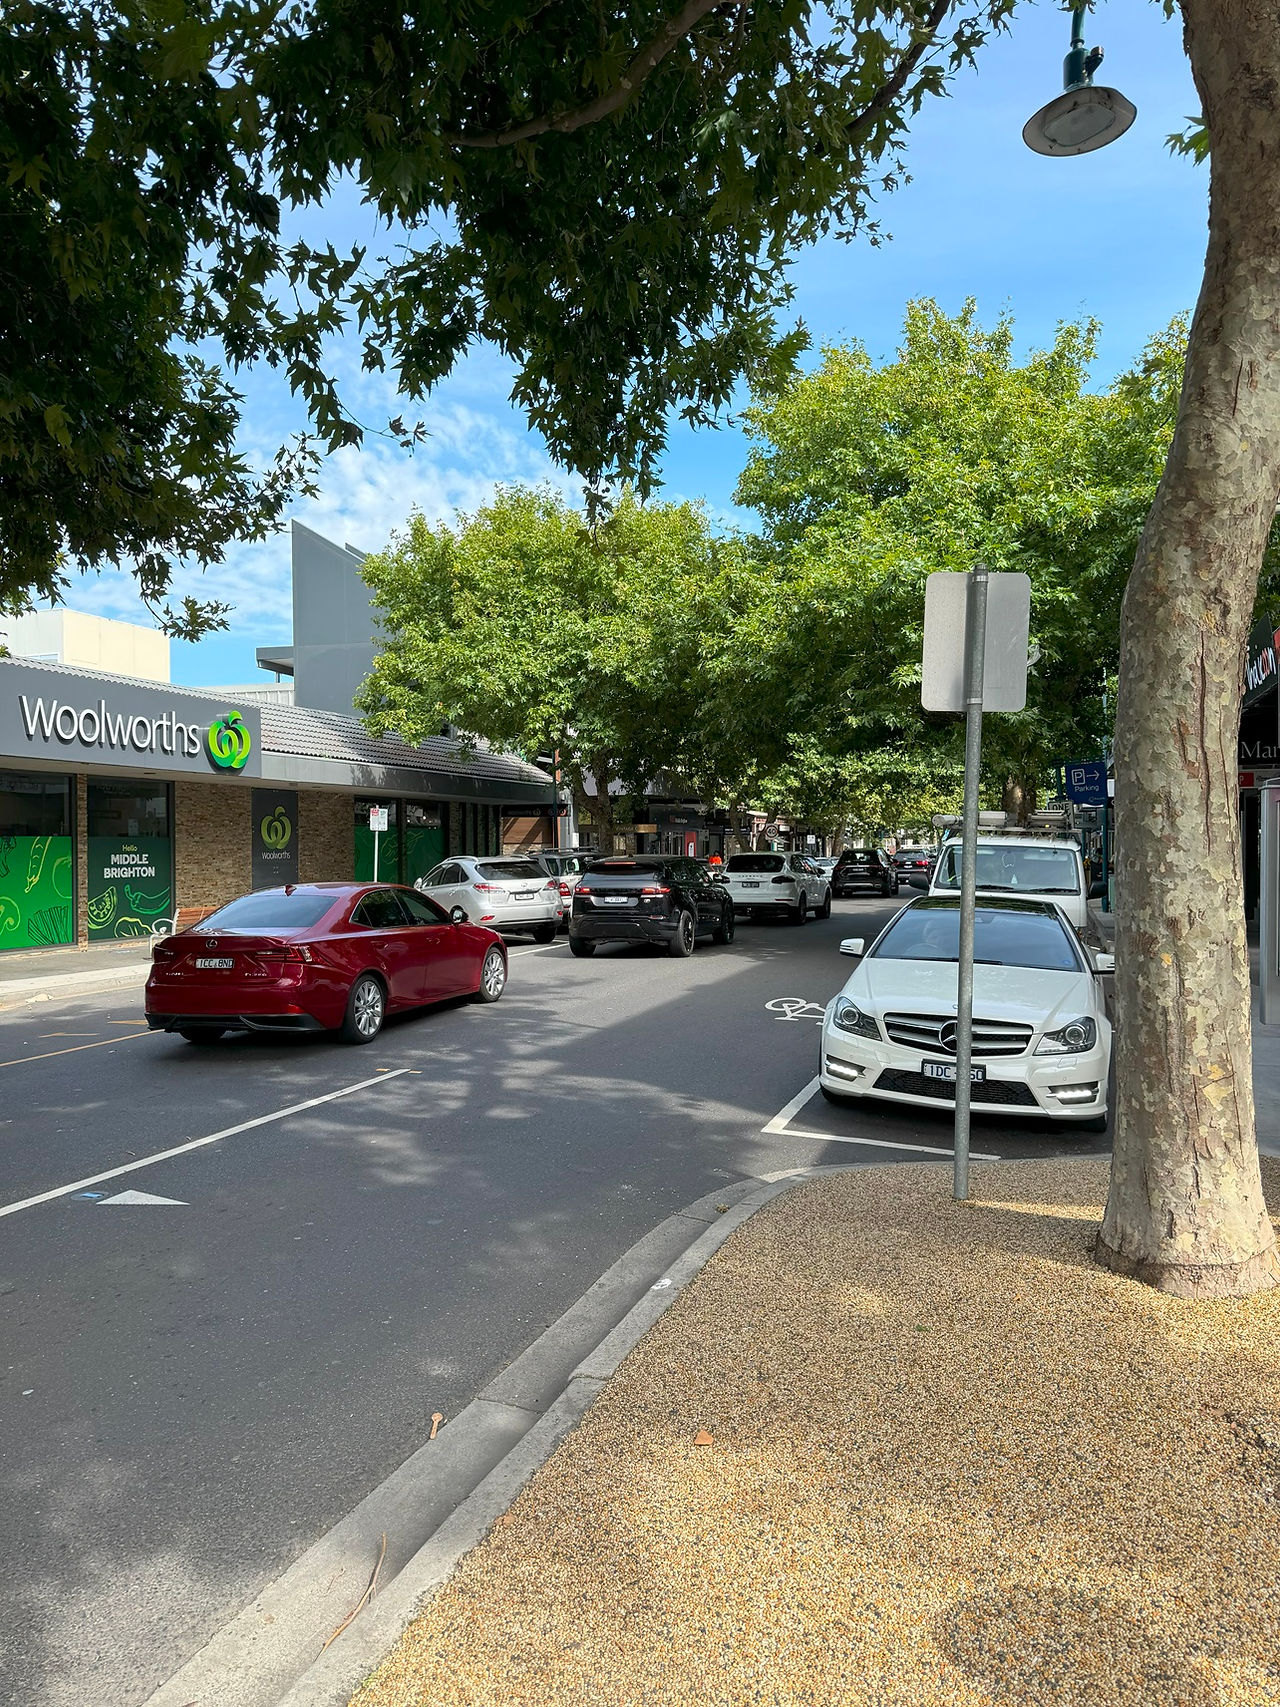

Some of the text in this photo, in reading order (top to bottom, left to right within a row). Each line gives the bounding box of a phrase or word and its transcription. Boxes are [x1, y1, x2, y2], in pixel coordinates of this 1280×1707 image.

[20, 695, 201, 754] Woolworths
[1074, 784, 1100, 793] Parking
[1052, 803, 1070, 811] ONE
[121, 844, 138, 852] Hello
[110, 853, 149, 865] MIDDLE
[261, 851, 291, 861] Woolworths
[103, 866, 156, 879] BRIGHTON
